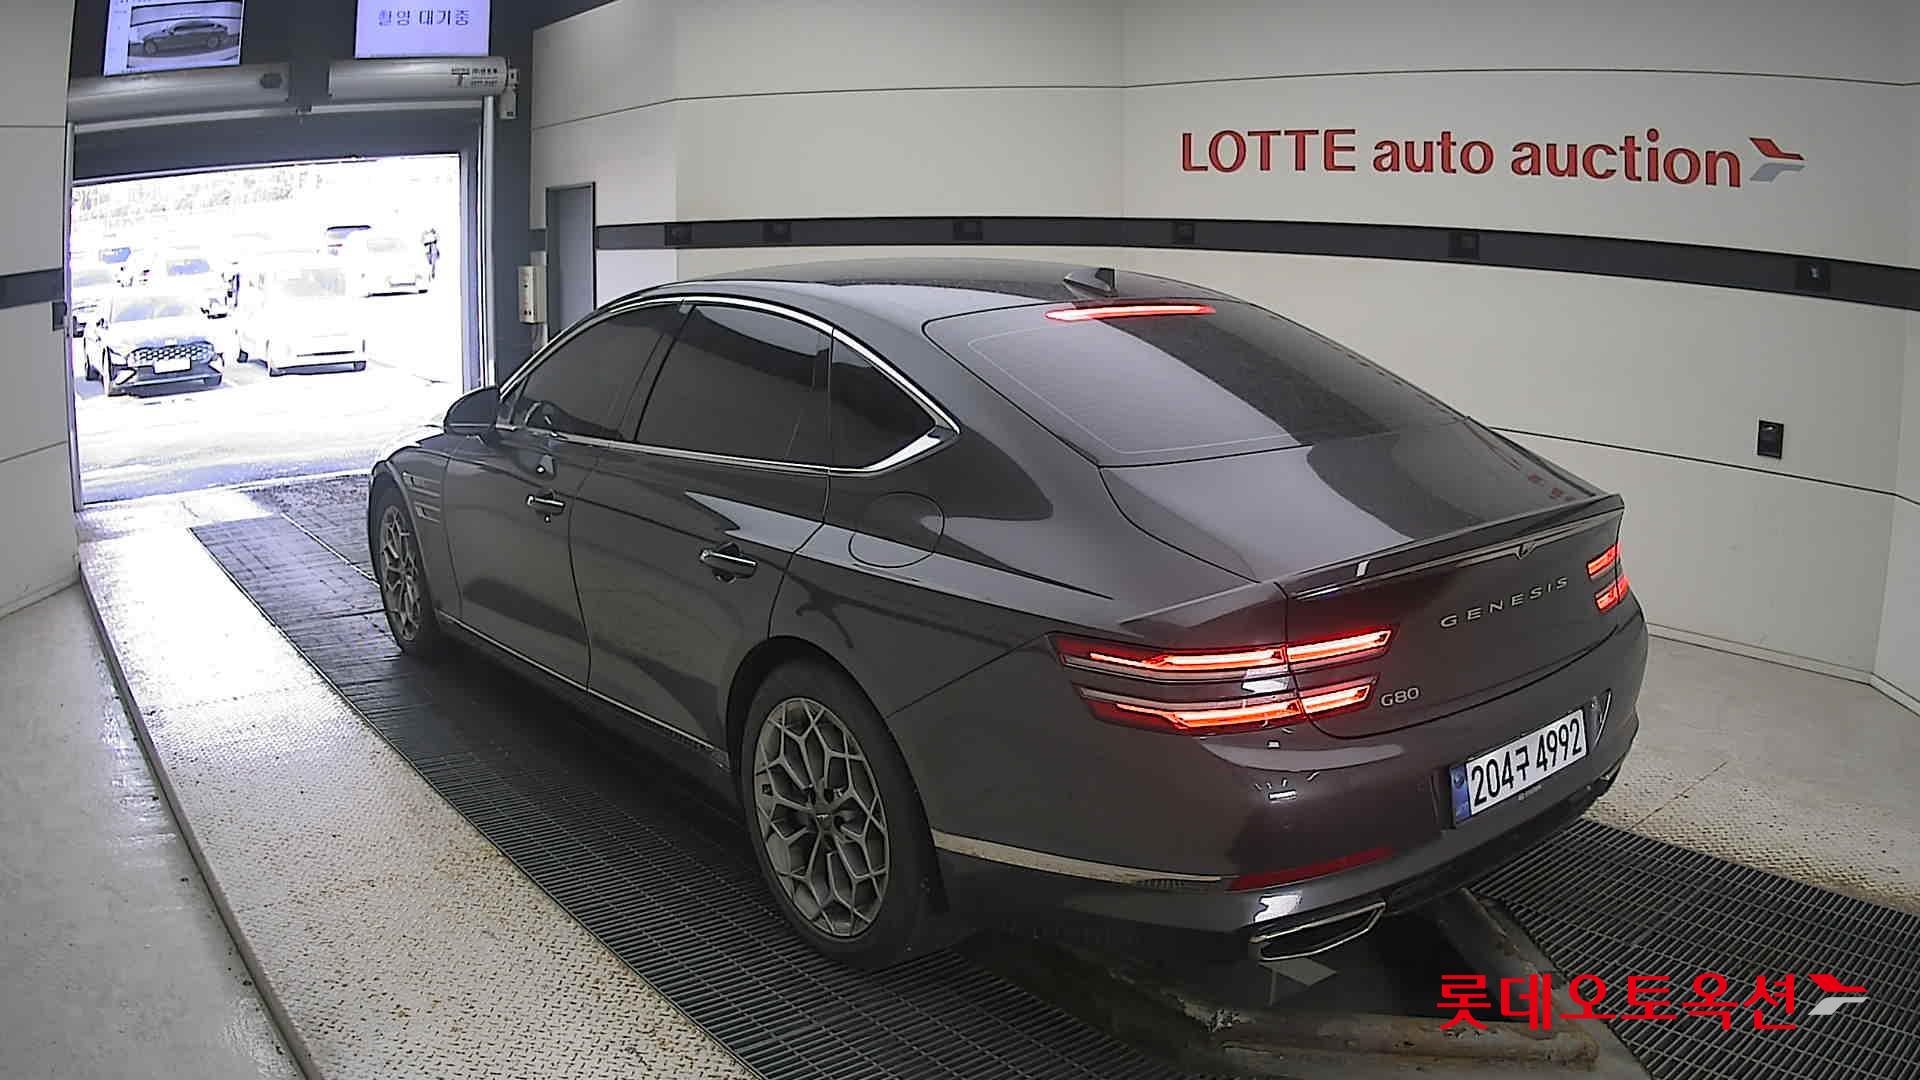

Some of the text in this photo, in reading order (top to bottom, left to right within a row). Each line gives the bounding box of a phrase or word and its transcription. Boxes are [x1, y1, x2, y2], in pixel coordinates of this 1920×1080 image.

[419, 9, 470, 26] 대기중
[1182, 128, 1742, 188] LOTTE auto auction
[1439, 576, 1569, 628] GENESIS
[1380, 687, 1420, 707] G80
[1471, 717, 1583, 807] 204구 4992
